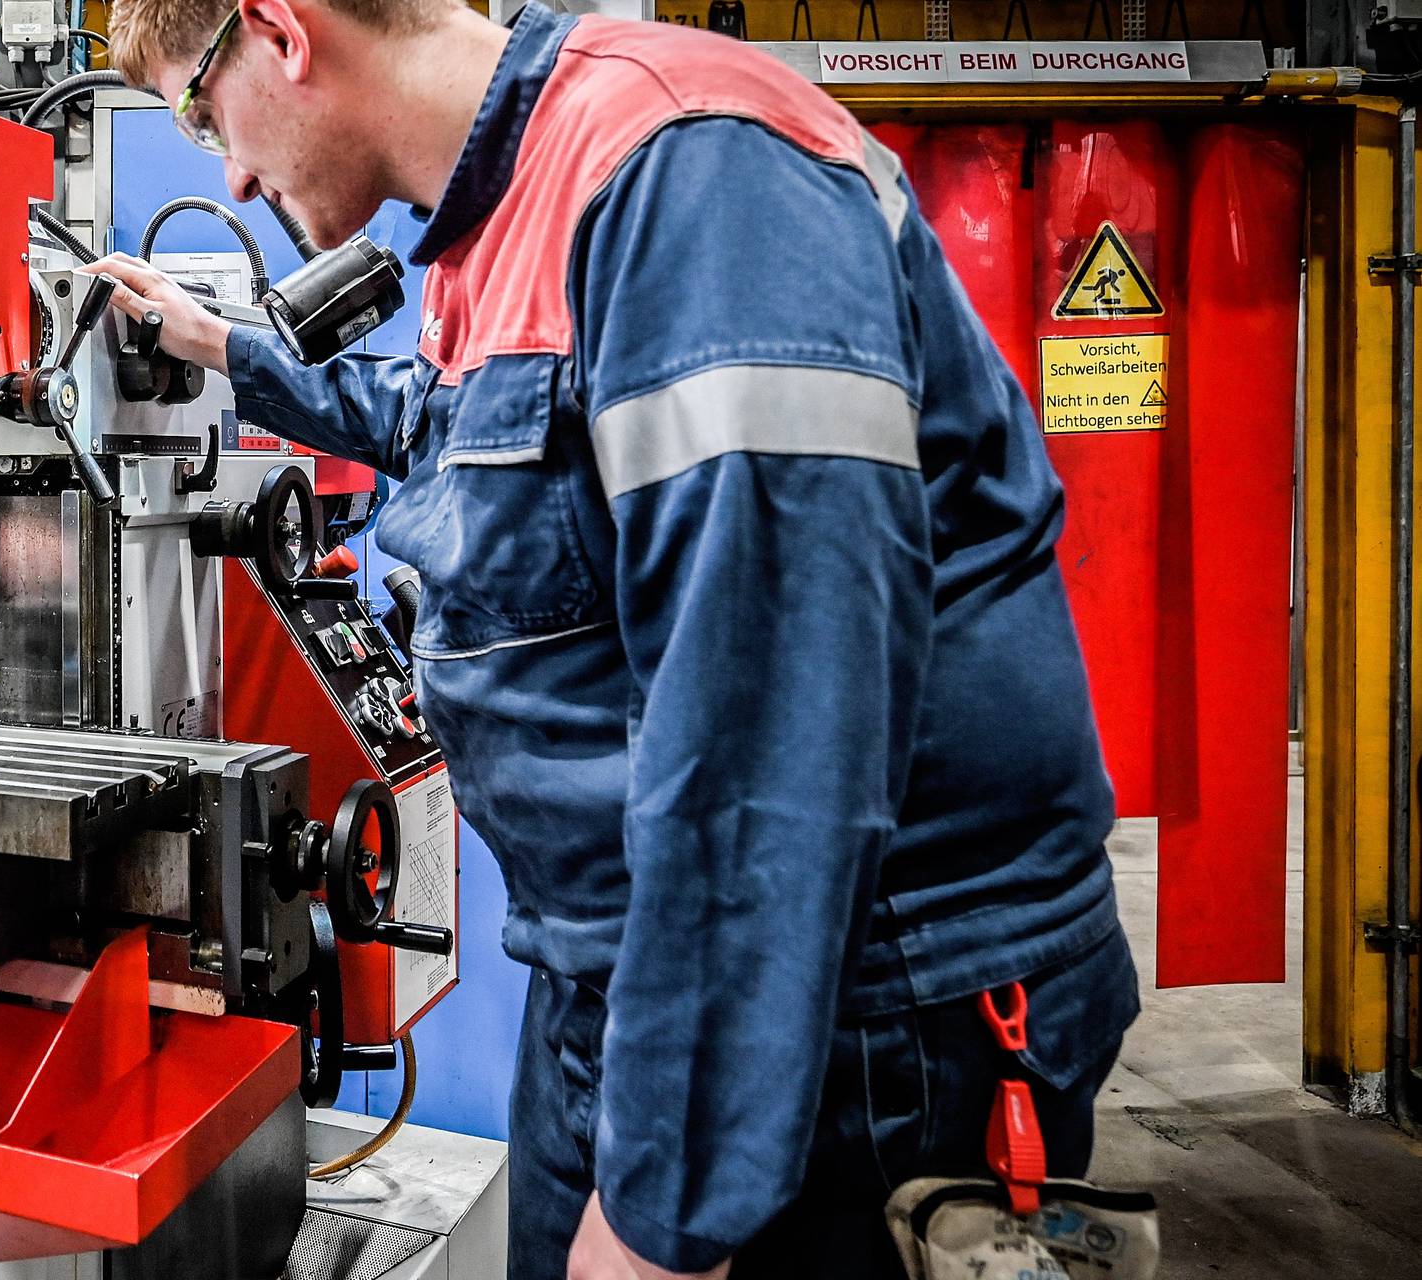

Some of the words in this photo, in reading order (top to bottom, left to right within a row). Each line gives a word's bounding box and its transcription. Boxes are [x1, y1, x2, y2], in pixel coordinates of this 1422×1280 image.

[823, 53, 944, 72] VORSICHT
[959, 53, 1018, 71] BEIM
[1031, 52, 1186, 70] DURCHGANG
[1079, 341, 1141, 357] Vorsicht,
[1050, 360, 1167, 377] Schweißarbeiten
[1046, 394, 1083, 408] Nicht
[1086, 393, 1099, 406] in
[1102, 392, 1130, 406] den
[1047, 414, 1123, 429] Lichtbogen
